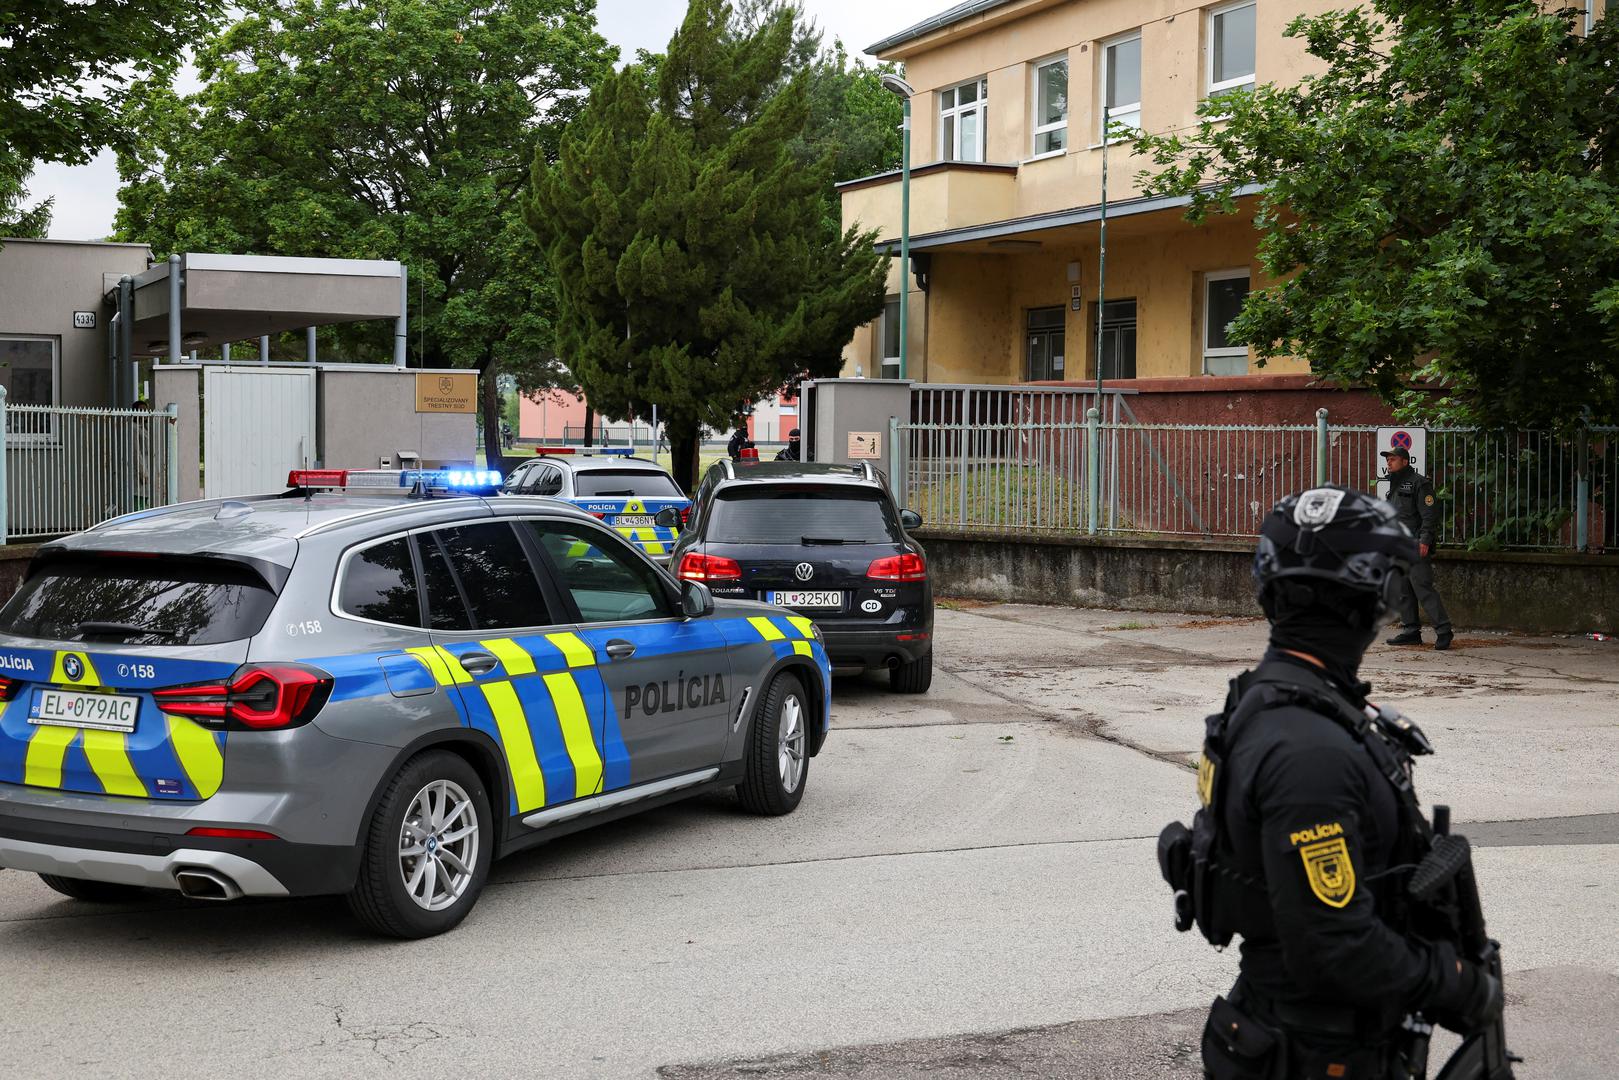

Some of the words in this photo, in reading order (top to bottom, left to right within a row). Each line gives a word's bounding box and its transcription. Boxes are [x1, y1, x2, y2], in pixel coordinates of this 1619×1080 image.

[76, 314, 94, 325] 4334
[616, 516, 626, 525] BL
[775, 592, 791, 605] BL
[865, 602, 878, 610] CD
[299, 620, 322, 635] 158
[0, 654, 34, 671] OLÍCIA
[130, 665, 155, 679] 158
[624, 670, 726, 720] POLÍCIA
[45, 695, 65, 716] EL
[74, 697, 131, 721] 079AC
[1290, 823, 1344, 846] POLÍCIA
